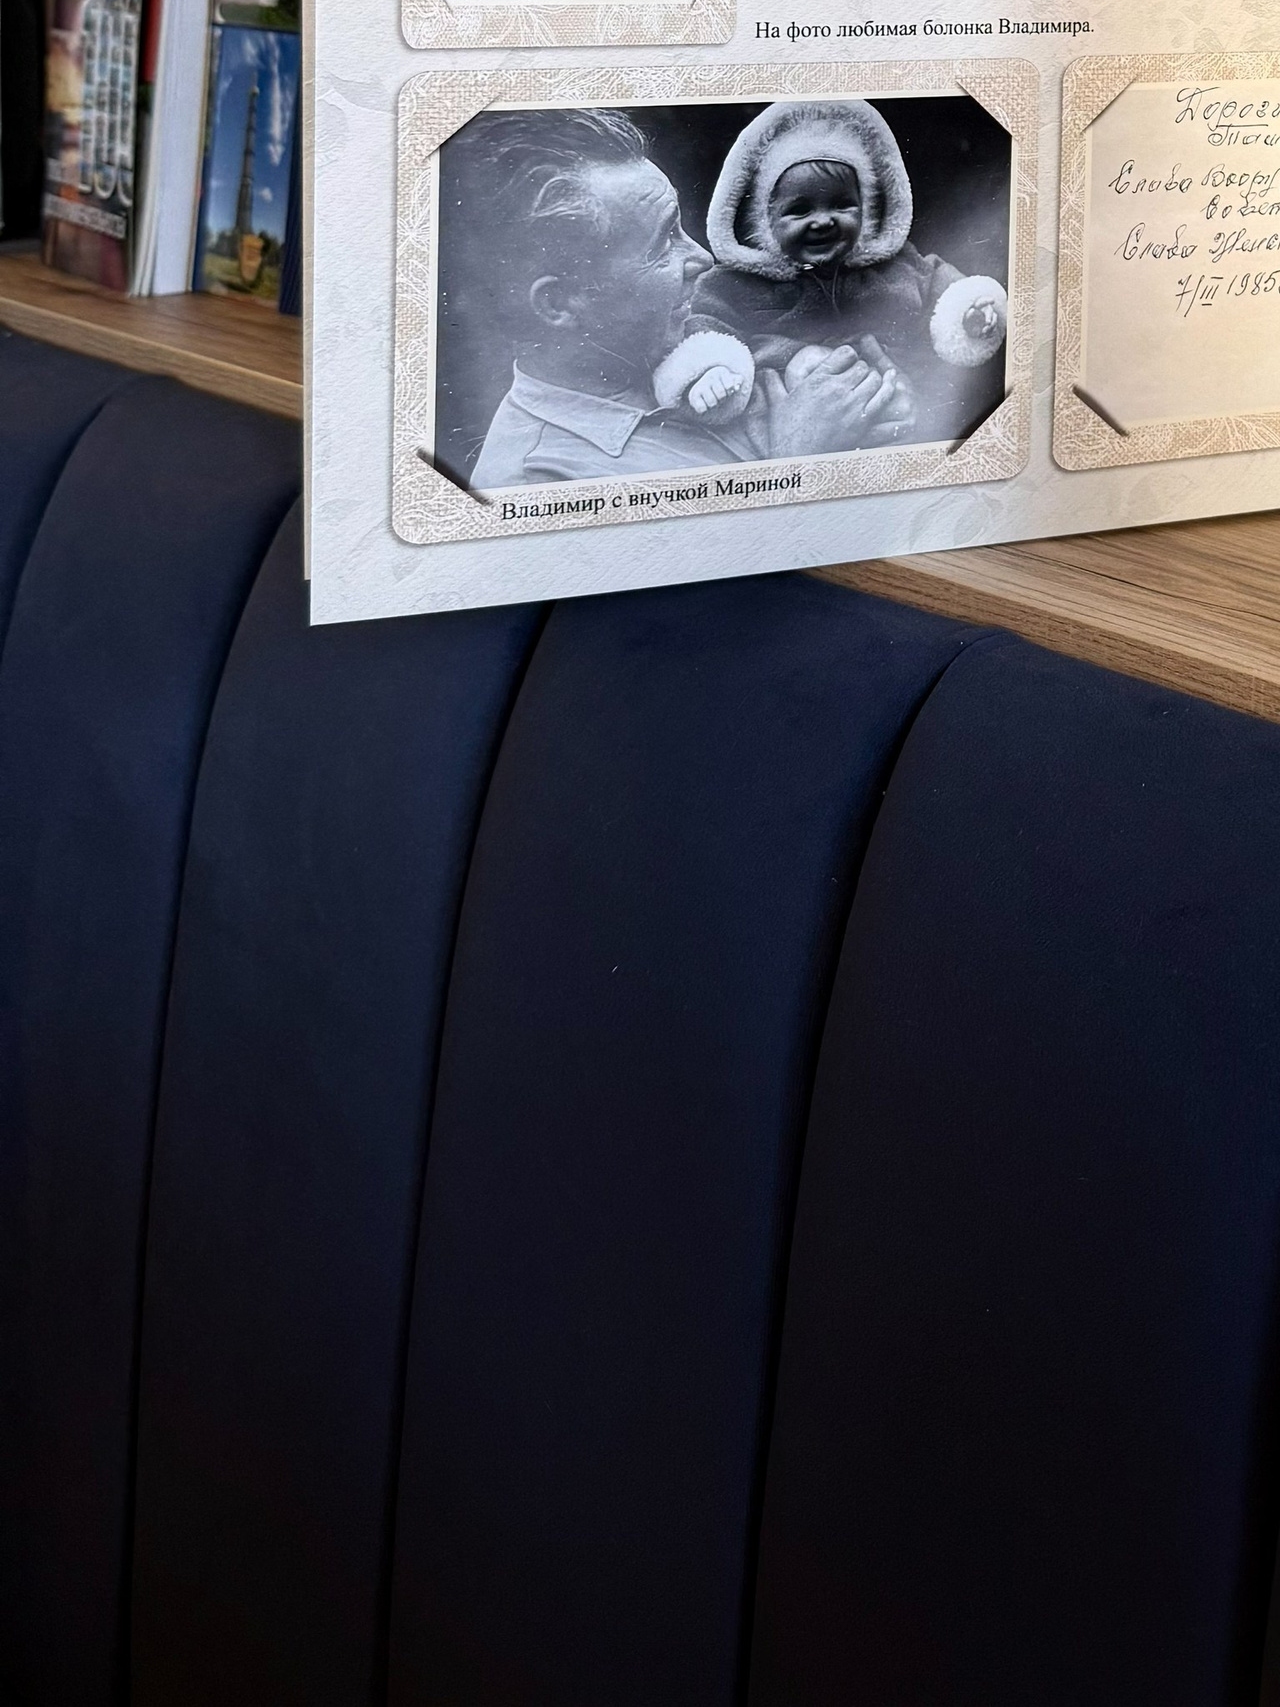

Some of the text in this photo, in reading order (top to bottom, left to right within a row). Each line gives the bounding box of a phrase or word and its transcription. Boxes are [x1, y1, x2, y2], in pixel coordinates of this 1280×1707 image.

[755, 18, 1094, 42] На фото любимая болонка Владимира.
[501, 473, 802, 520] Владимир с внучкой Мариной
